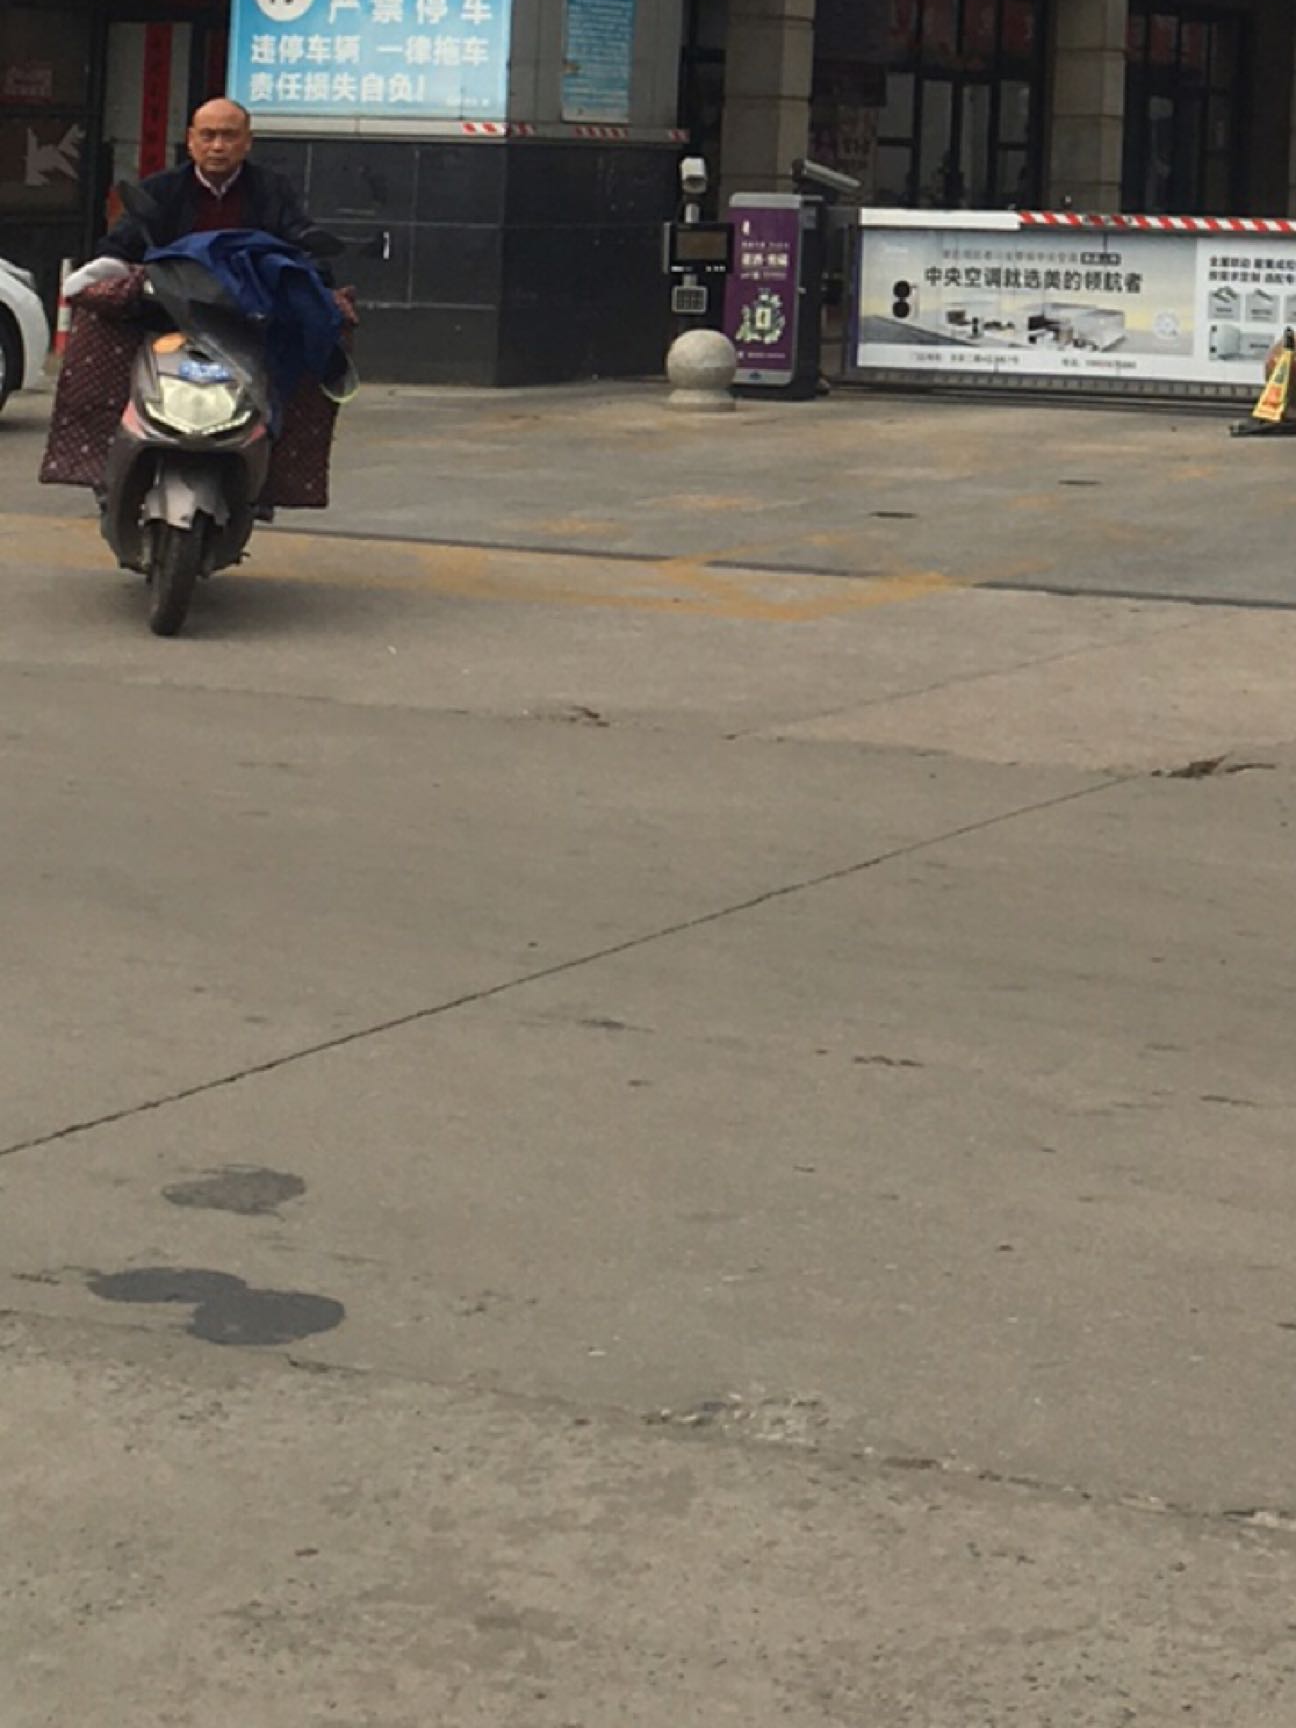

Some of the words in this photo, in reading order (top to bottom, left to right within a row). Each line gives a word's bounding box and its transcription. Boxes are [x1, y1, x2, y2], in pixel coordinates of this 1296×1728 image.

[251, 34, 361, 65] 违停车辆
[375, 34, 490, 65] 一律拖车
